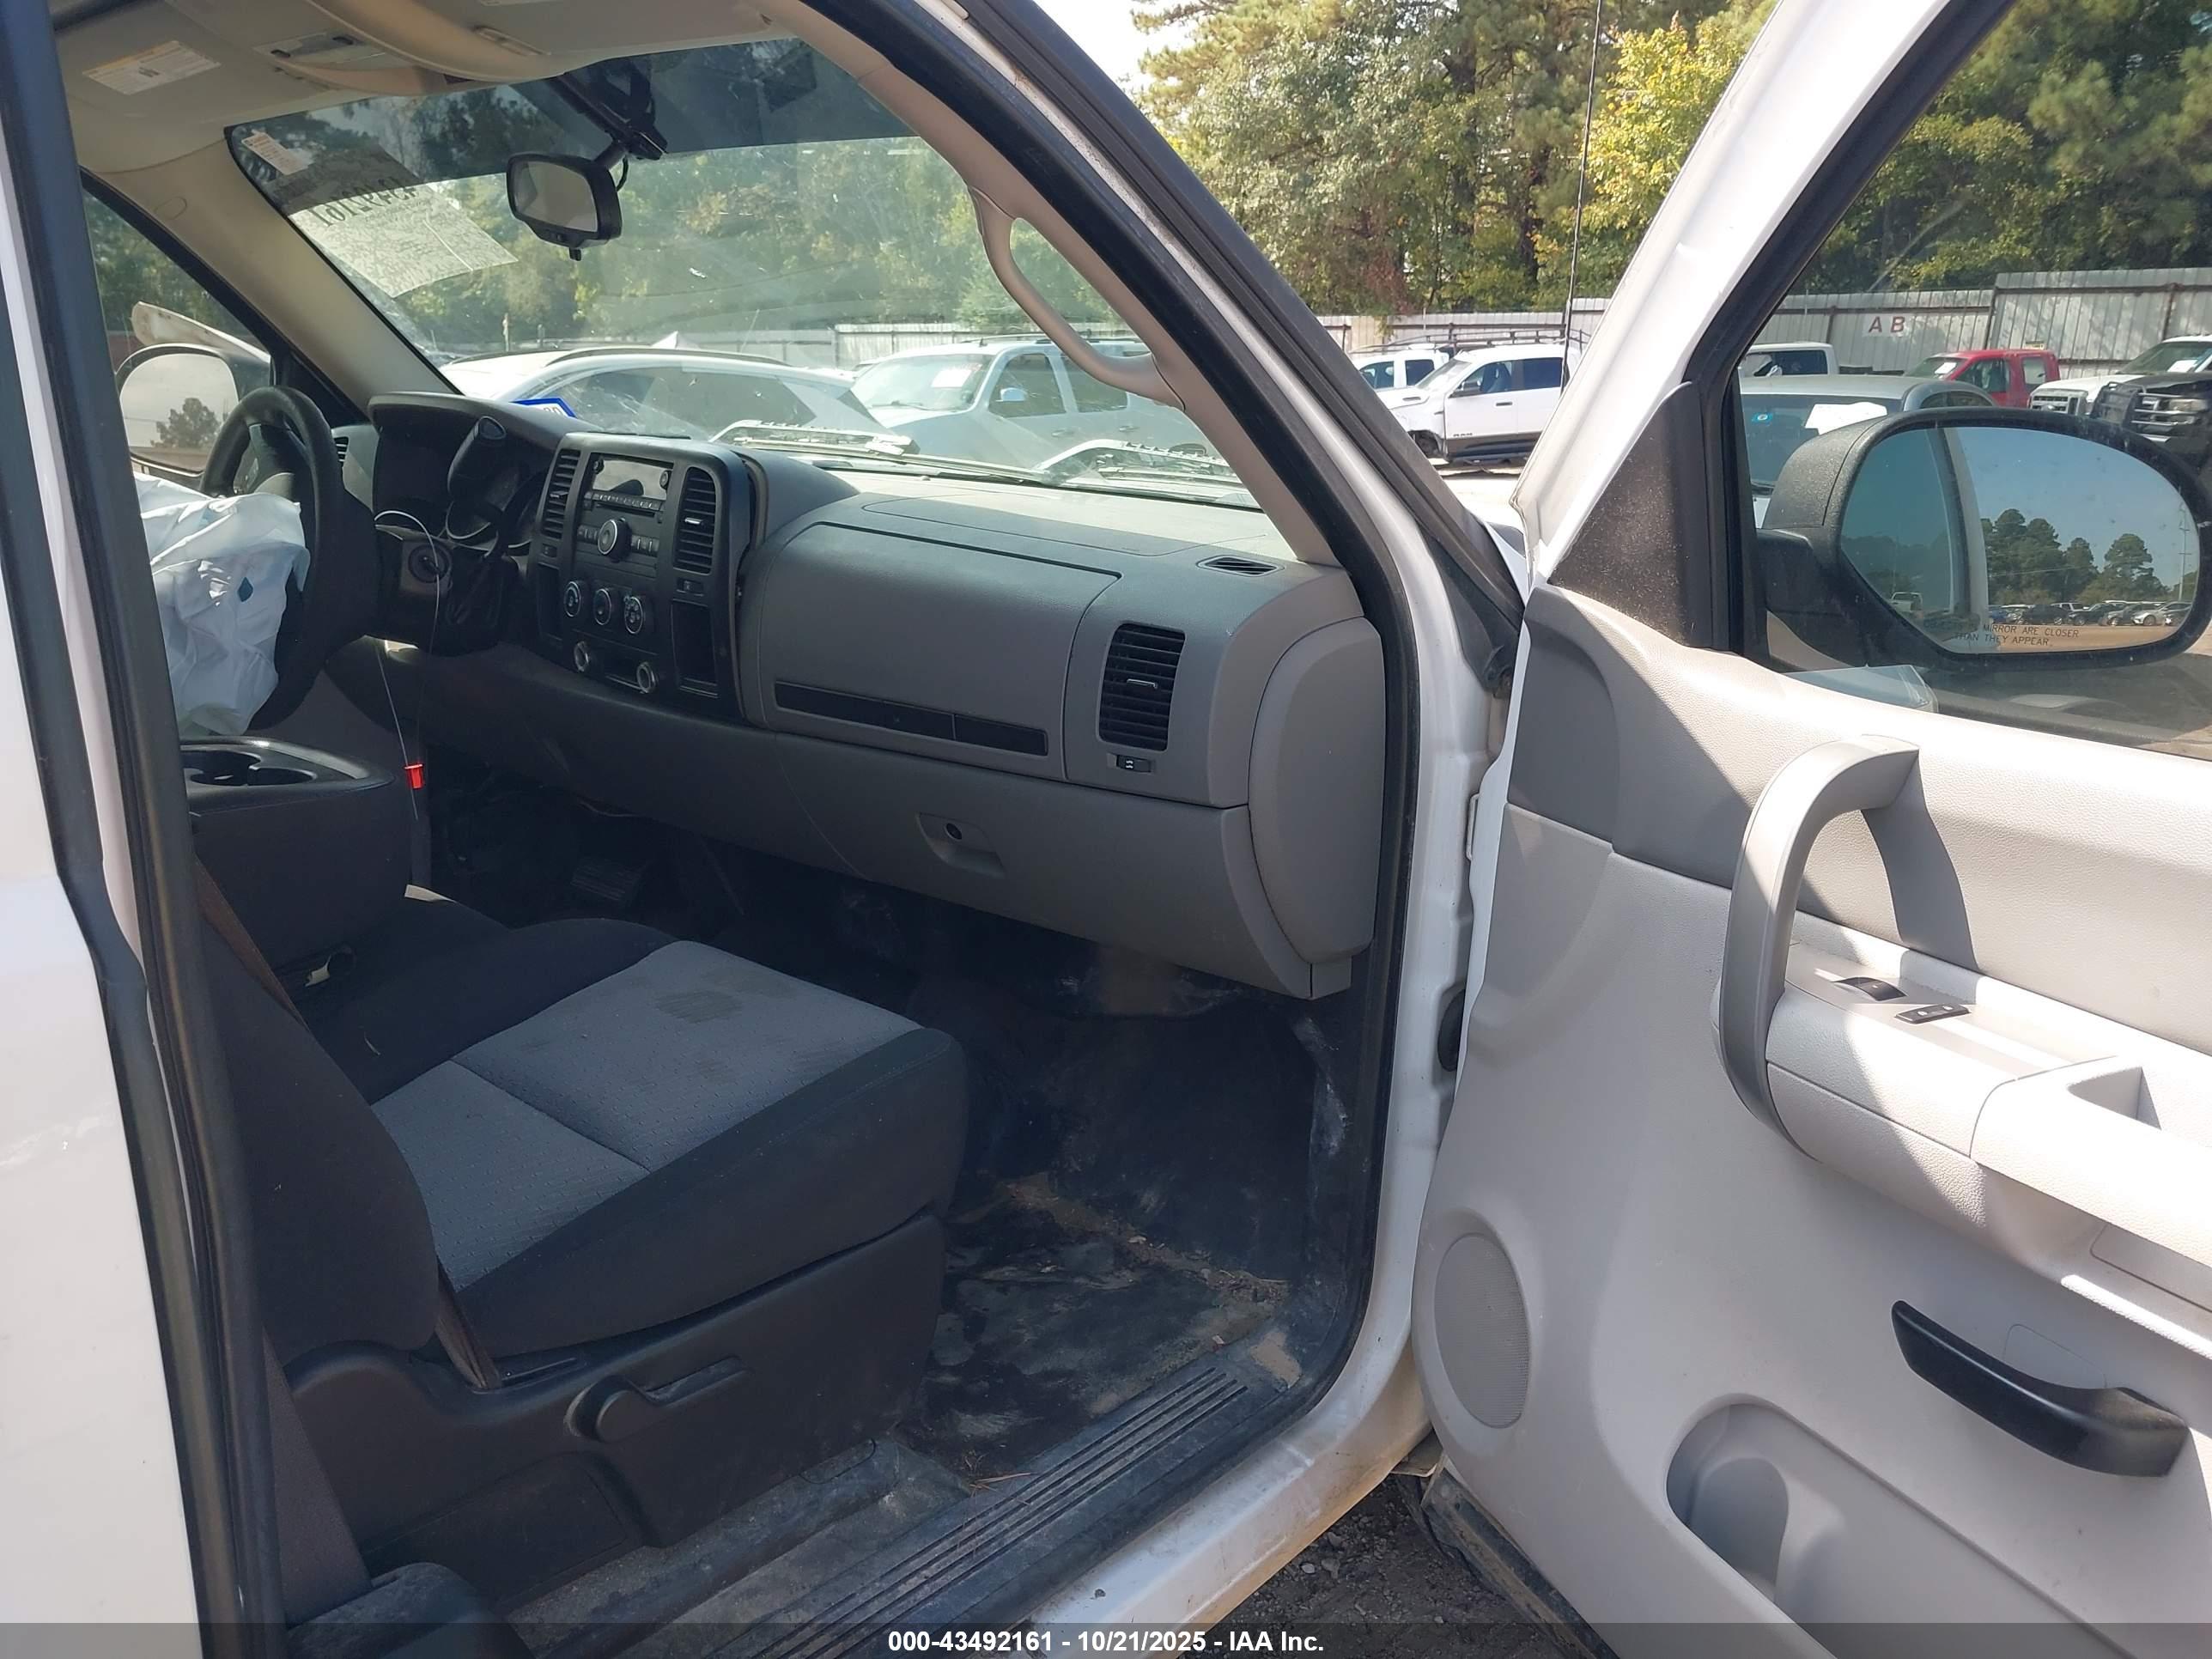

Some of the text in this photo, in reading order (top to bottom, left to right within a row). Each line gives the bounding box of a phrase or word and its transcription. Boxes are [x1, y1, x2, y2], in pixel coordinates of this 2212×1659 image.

[1984, 623, 2017, 634] MIRROR
[2021, 626, 2039, 635] ARE
[2044, 628, 2080, 638] CLOSER
[1984, 634, 2008, 643] THEY
